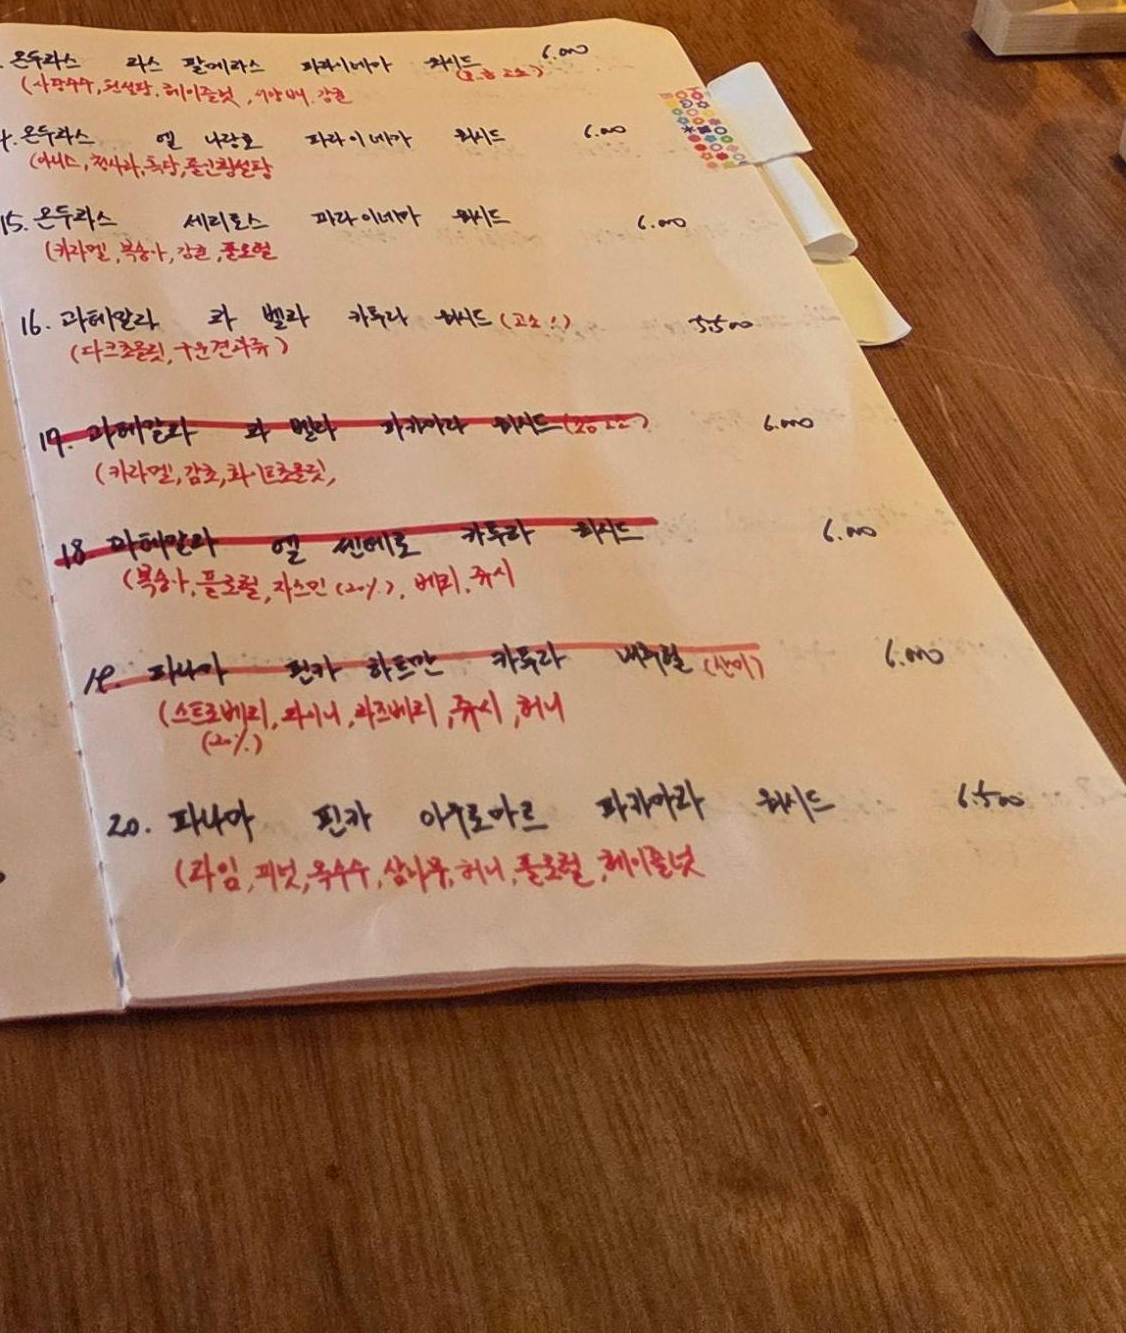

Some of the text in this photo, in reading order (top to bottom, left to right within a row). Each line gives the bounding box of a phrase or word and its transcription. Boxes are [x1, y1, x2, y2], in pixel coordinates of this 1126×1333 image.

[9, 49, 82, 72] 온두라스
[125, 53, 163, 75] 라스
[19, 124, 96, 148] 온두라스
[155, 129, 183, 151] 엘
[0, 209, 29, 237] 15.
[32, 204, 118, 232] 온두라스
[20, 307, 51, 337] 16.
[106, 813, 152, 838] 20.
